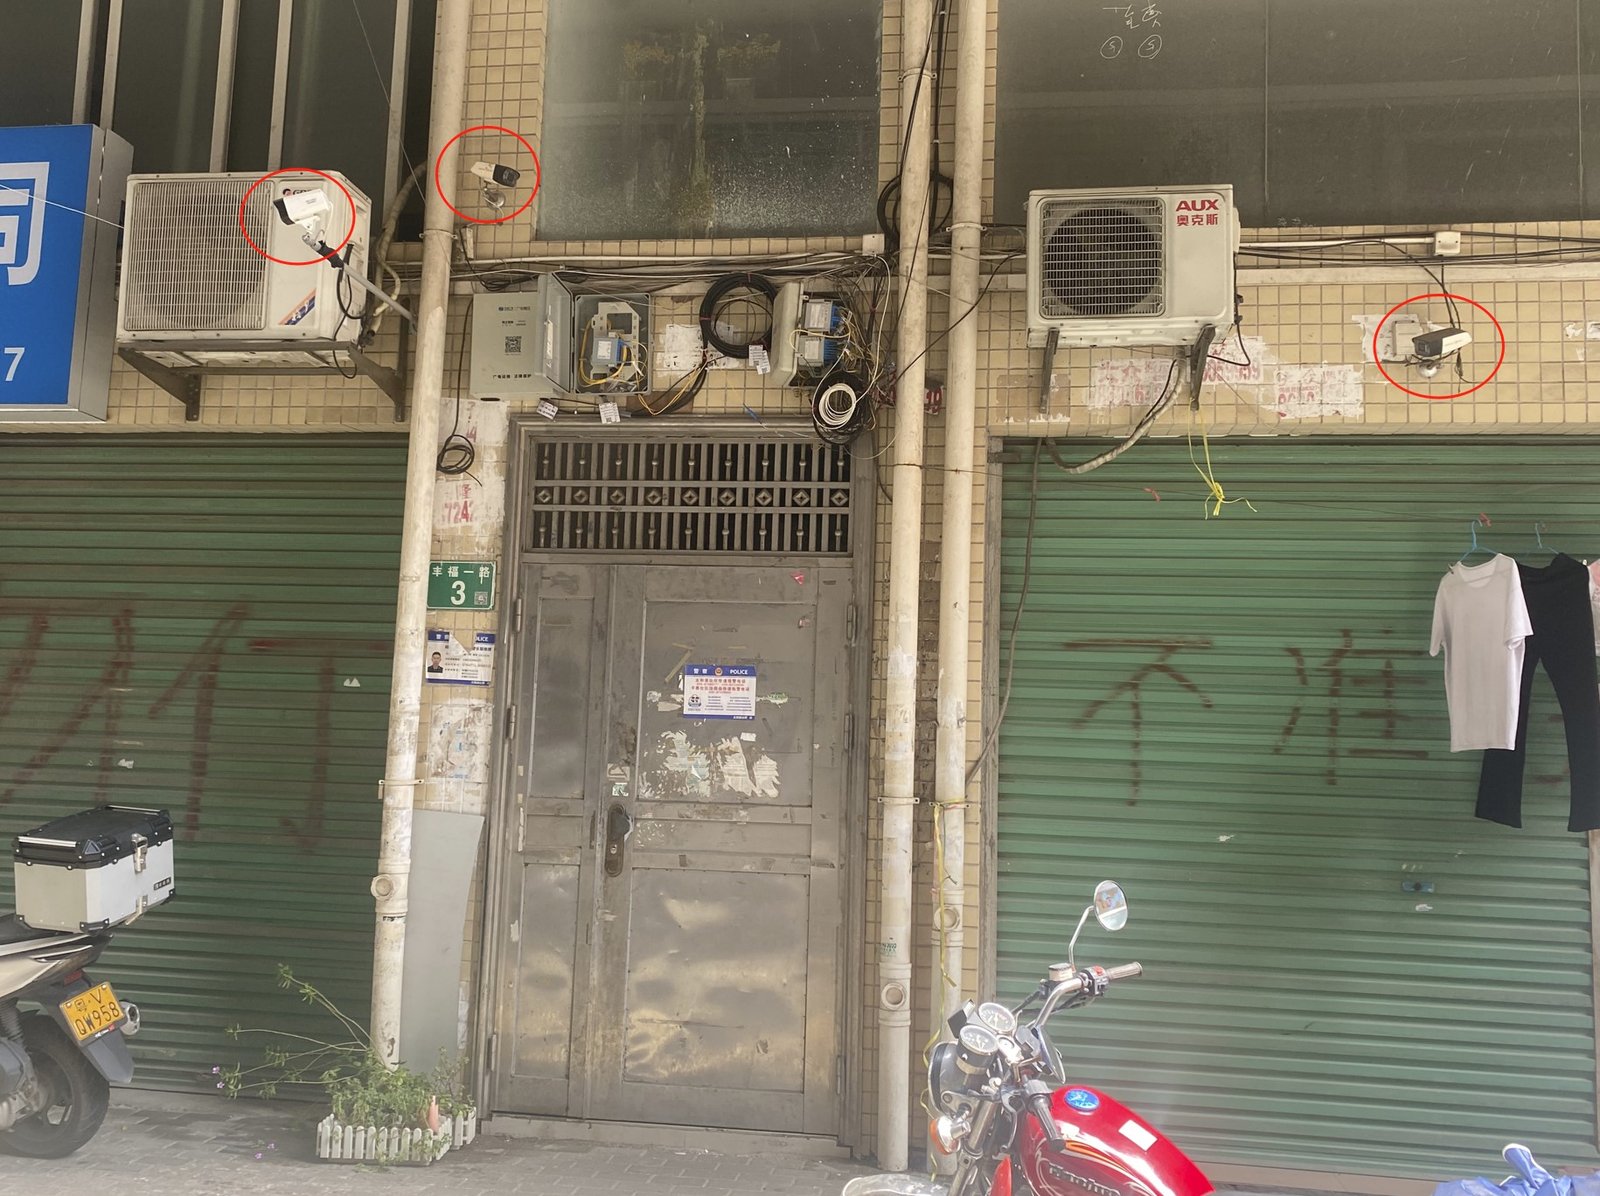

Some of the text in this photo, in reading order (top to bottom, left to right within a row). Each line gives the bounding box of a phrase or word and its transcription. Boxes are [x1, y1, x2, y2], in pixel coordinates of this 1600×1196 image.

[1176, 199, 1219, 212] AUX
[1176, 213, 1219, 226] 奥克斯
[450, 580, 466, 605] 3
[74, 1001, 121, 1036] QW958
